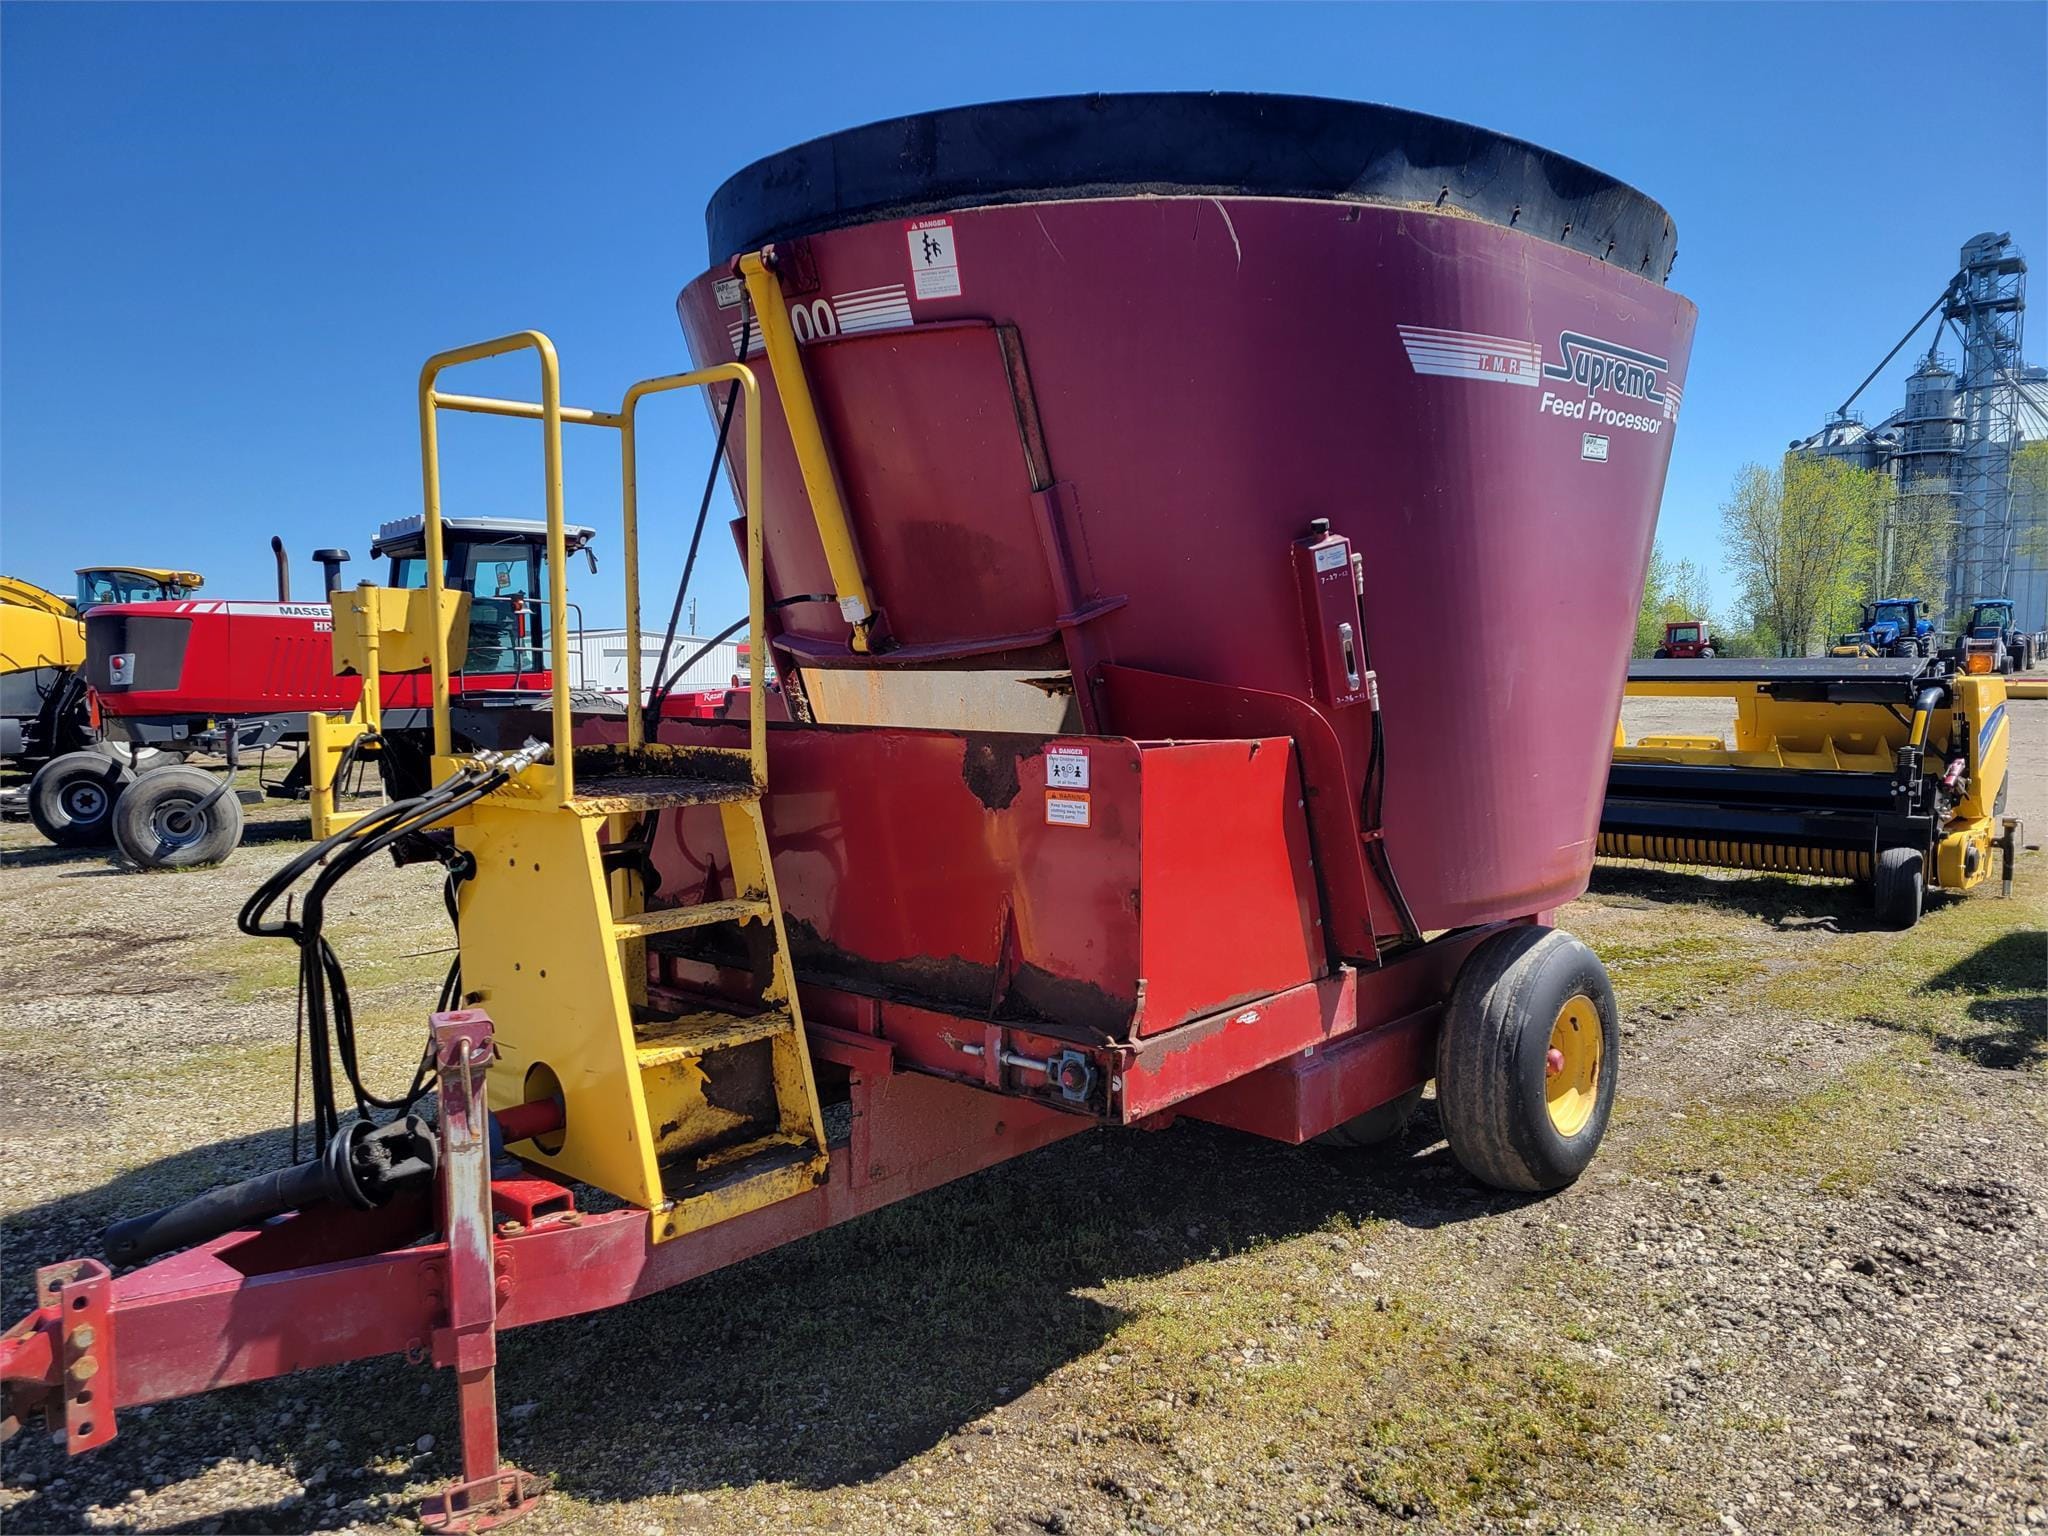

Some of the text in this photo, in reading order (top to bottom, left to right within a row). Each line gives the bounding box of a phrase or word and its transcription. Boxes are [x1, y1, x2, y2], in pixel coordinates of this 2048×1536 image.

[918, 218, 947, 229] DANGER
[1542, 330, 1669, 405] Supreme
[1540, 391, 1587, 419] Feed
[1588, 401, 1662, 434] Processor
